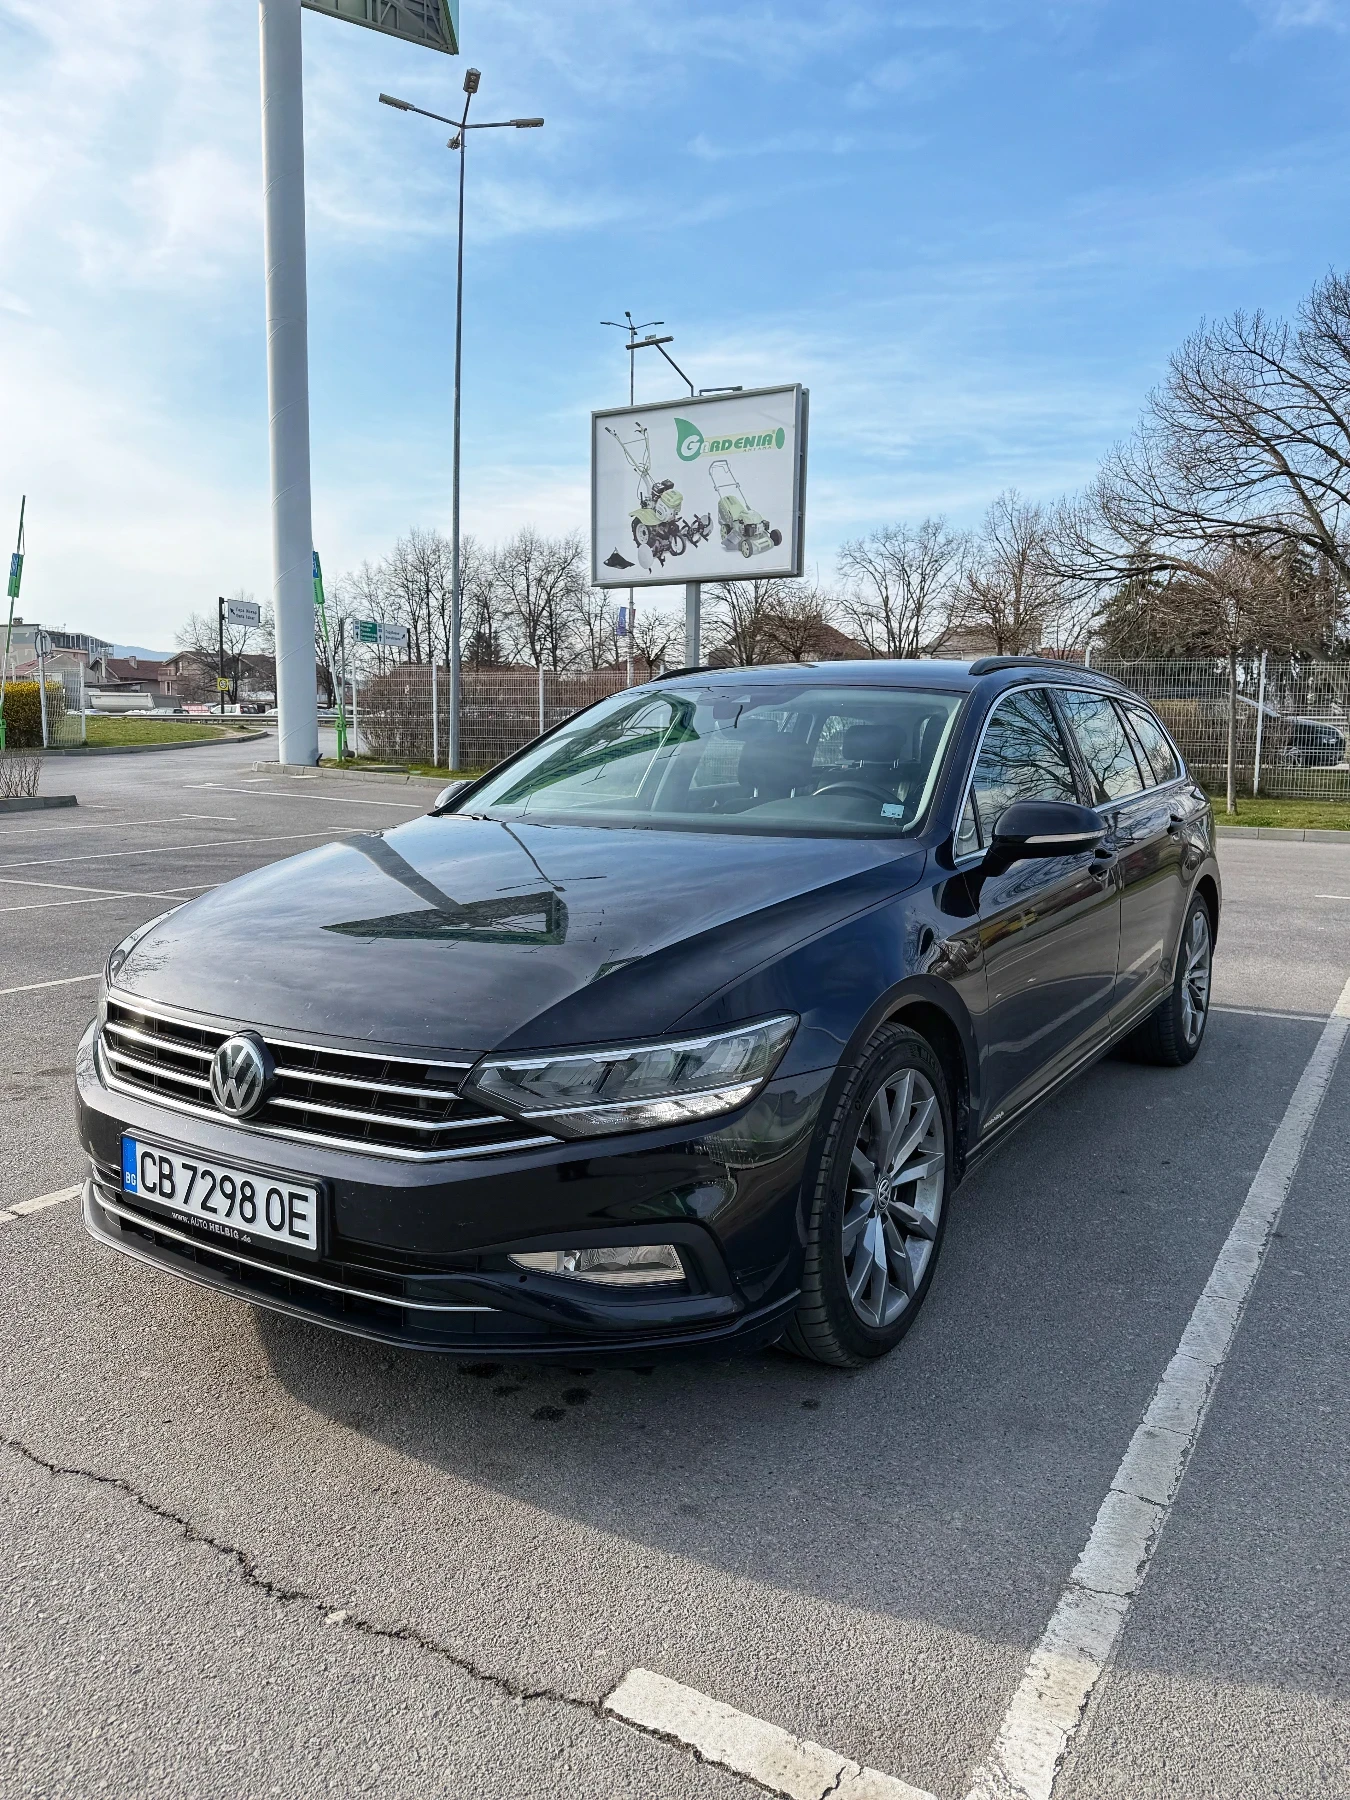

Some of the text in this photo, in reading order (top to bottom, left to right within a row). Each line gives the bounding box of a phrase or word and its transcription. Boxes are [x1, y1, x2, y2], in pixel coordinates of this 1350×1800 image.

[681, 433, 773, 456] GARDENIA
[125, 1171, 137, 1186] BG
[181, 1162, 257, 1224] 7298
